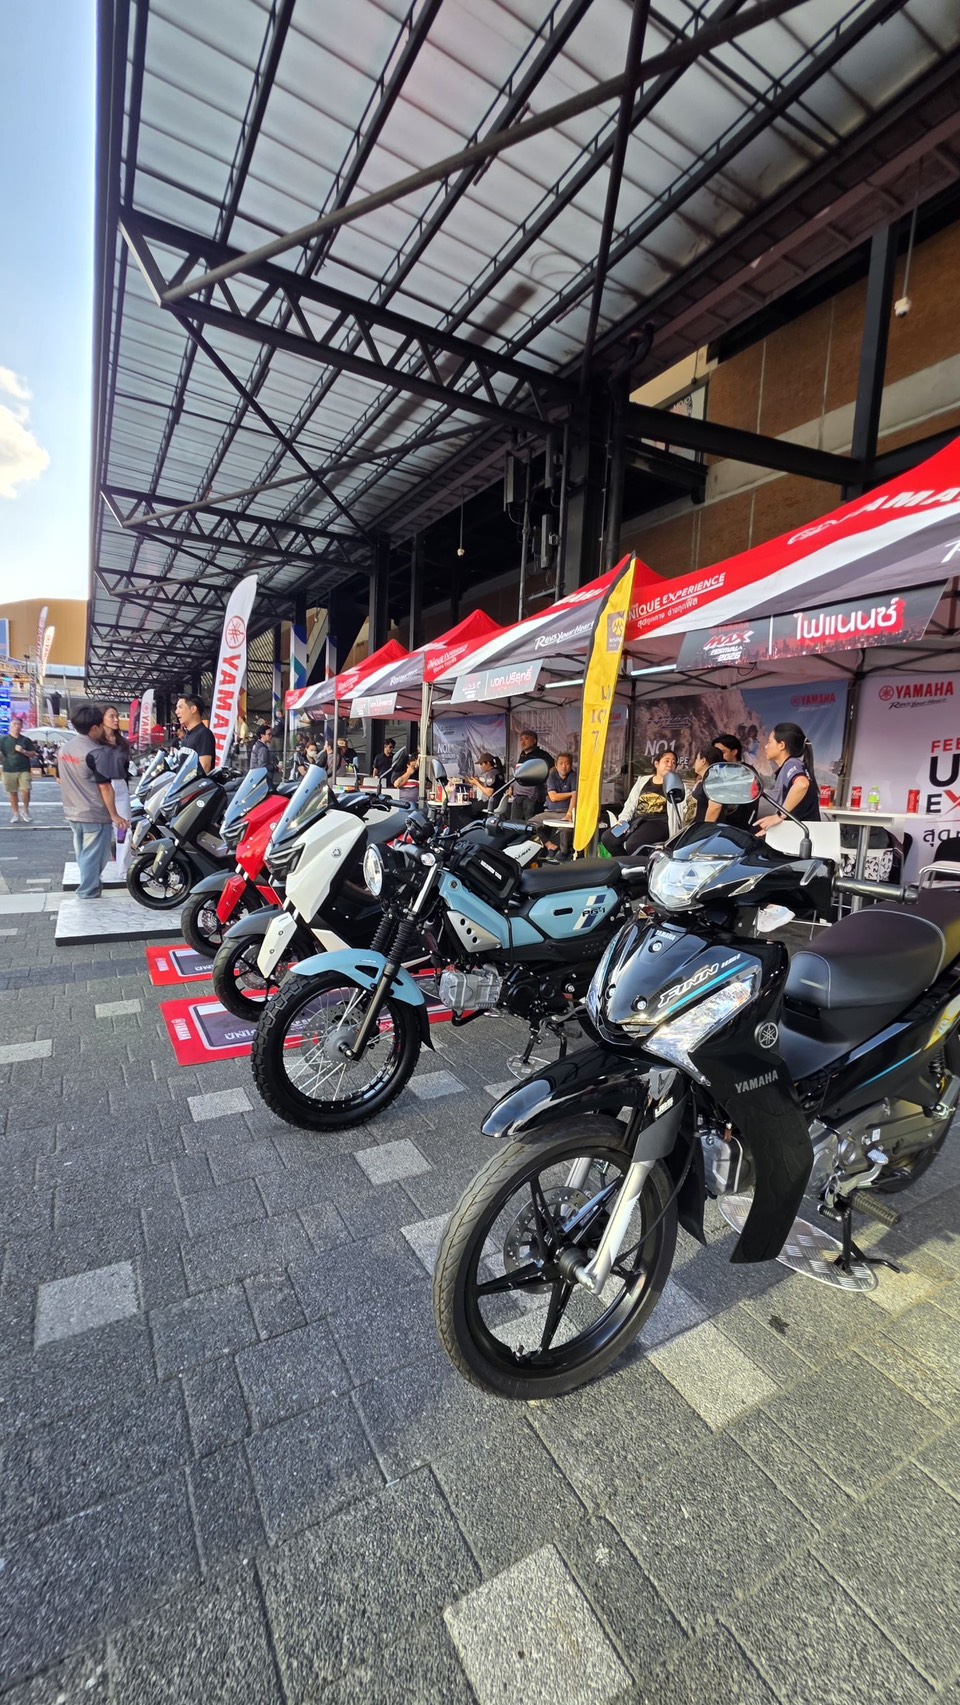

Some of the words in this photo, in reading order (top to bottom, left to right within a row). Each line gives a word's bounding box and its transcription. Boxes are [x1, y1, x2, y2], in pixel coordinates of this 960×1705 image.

[629, 597, 661, 620] NIQUE
[662, 572, 726, 604] EXPERIENCE
[793, 597, 899, 641] ไฟแนนซ์
[896, 681, 954, 699] YAMAHA
[655, 929, 676, 941] YAMAHA
[657, 963, 720, 1008] FINN
[735, 1070, 779, 1094] YAMAHA
